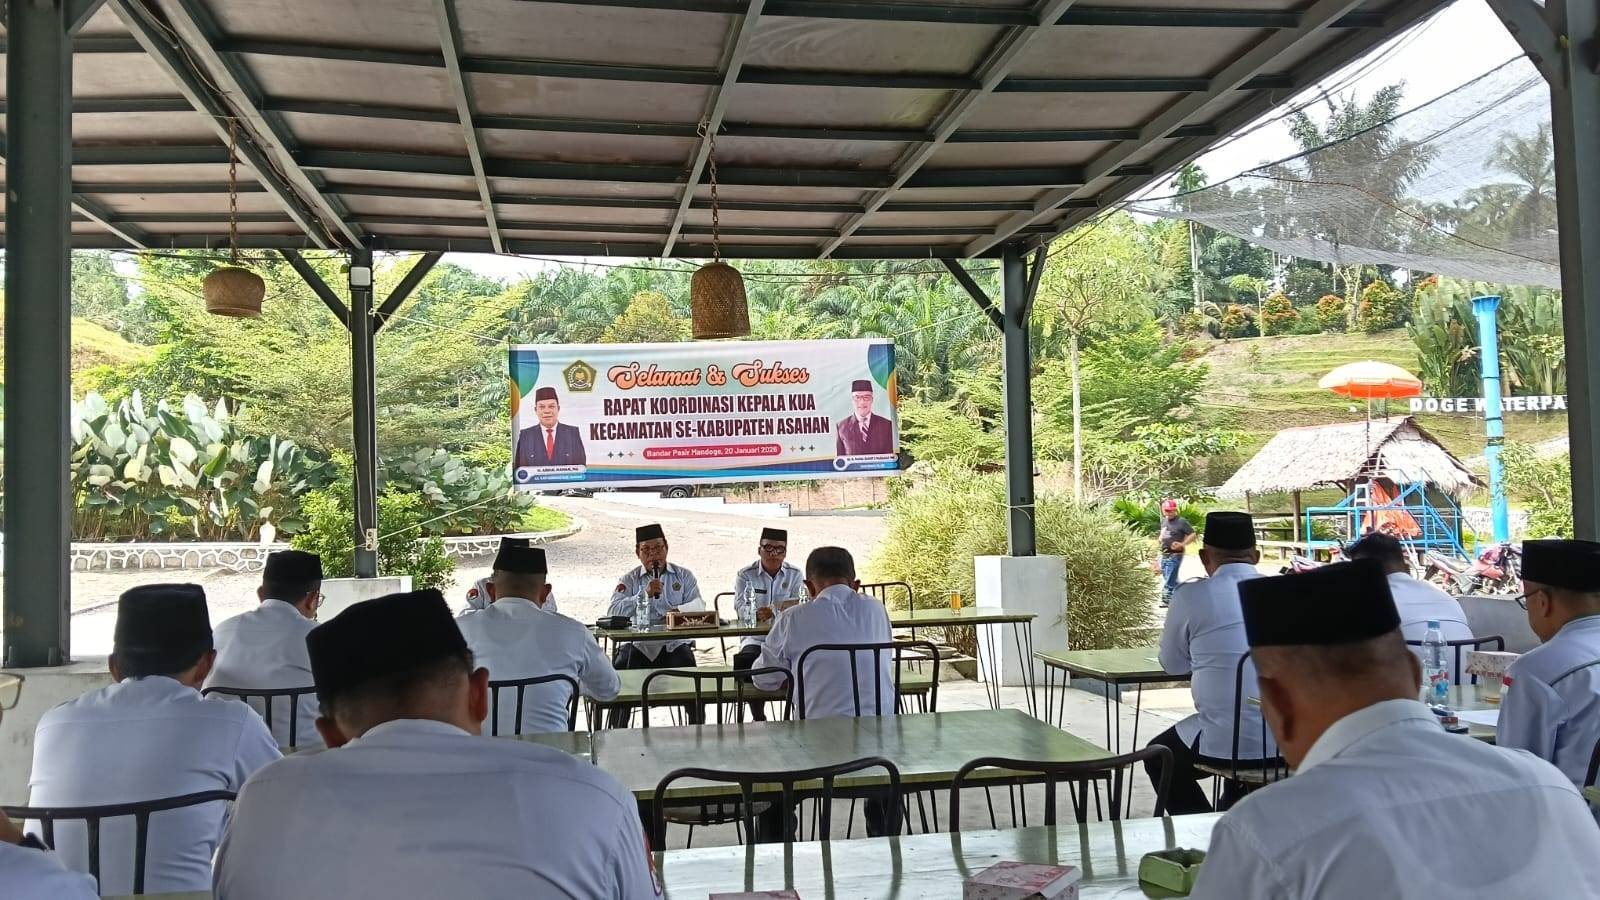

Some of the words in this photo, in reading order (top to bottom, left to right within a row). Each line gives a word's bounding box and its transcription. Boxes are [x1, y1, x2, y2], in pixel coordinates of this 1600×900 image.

[607, 361, 701, 390] Selamat
[706, 364, 726, 386] &
[732, 358, 810, 387] Sukses
[603, 397, 647, 416] RAPAT
[650, 395, 734, 415] KOORDINASI
[737, 394, 787, 413] KEPALA
[788, 393, 816, 411] KUA
[1410, 398, 1469, 412] DOGE
[590, 421, 673, 441] KECAMATAN
[675, 418, 774, 438] SE-KABUPATEN
[776, 416, 830, 435] ASAHAN
[724, 447, 734, 455] 20
